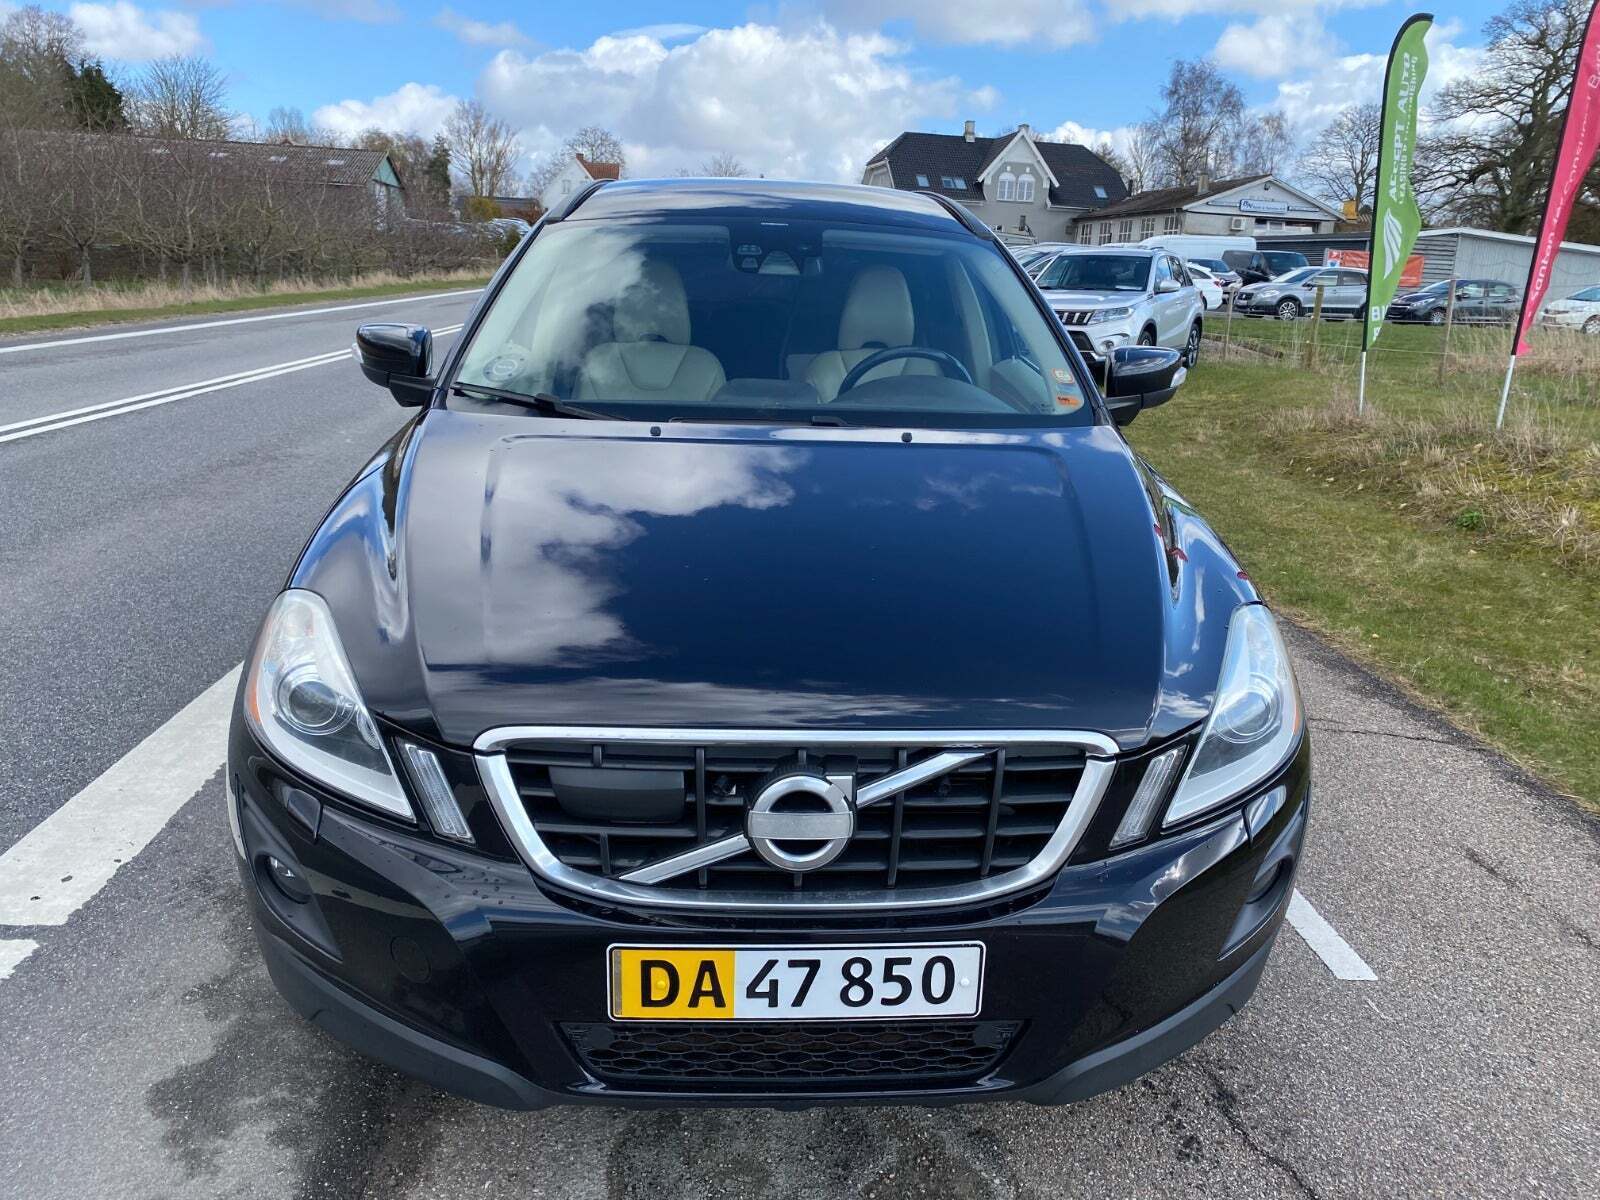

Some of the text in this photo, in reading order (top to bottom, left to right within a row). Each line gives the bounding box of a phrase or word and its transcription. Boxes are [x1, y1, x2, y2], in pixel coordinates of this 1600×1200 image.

[1397, 52, 1411, 113] AUTO
[640, 955, 956, 1009] DA 47 850
